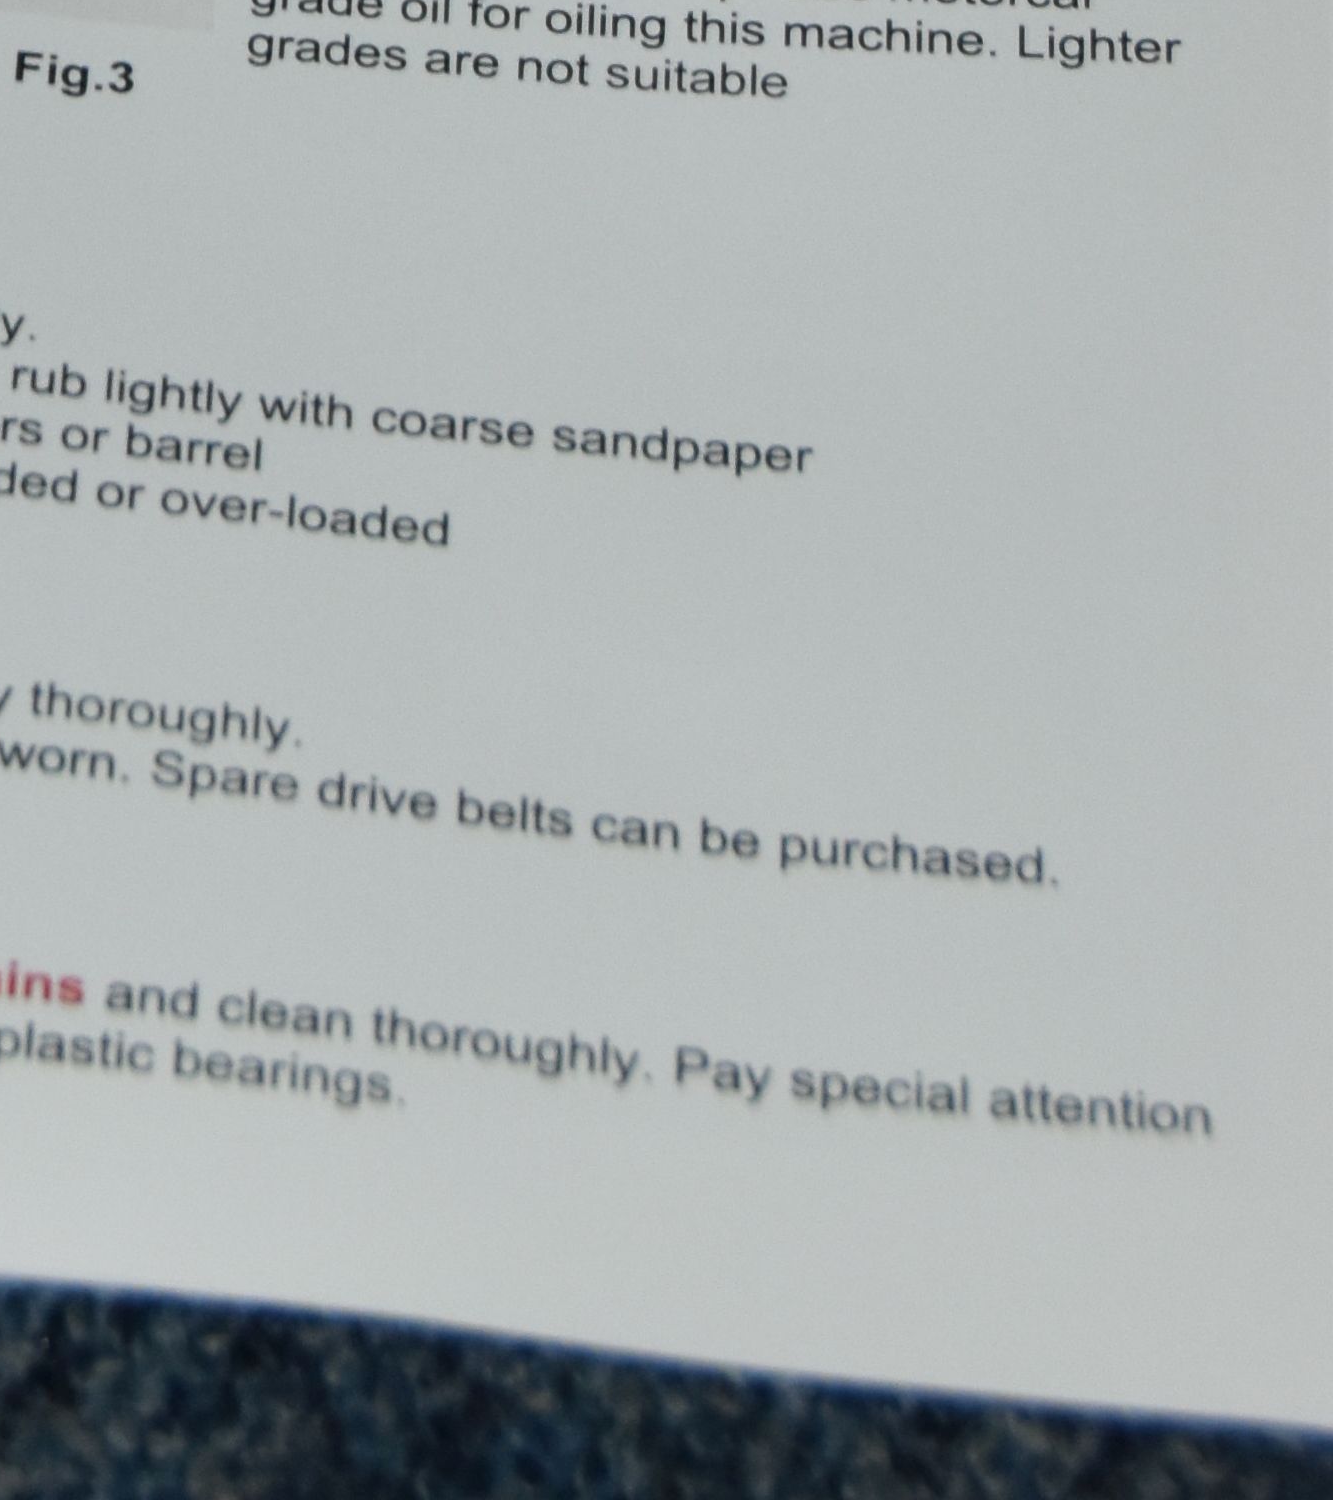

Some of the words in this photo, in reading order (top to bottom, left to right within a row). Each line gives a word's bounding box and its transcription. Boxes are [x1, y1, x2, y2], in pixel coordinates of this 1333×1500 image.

[14, 49, 135, 99] Fig.3
[246, 32, 408, 72] grades
[424, 48, 500, 80] are
[516, 54, 590, 88] not
[606, 61, 789, 99] suitable
[104, 982, 201, 1022] and
[217, 989, 354, 1040] clean
[372, 1008, 652, 1087] thoroughly.
[674, 1045, 770, 1104] Pay
[790, 1070, 971, 1115] special
[989, 1085, 1214, 1137] attention
